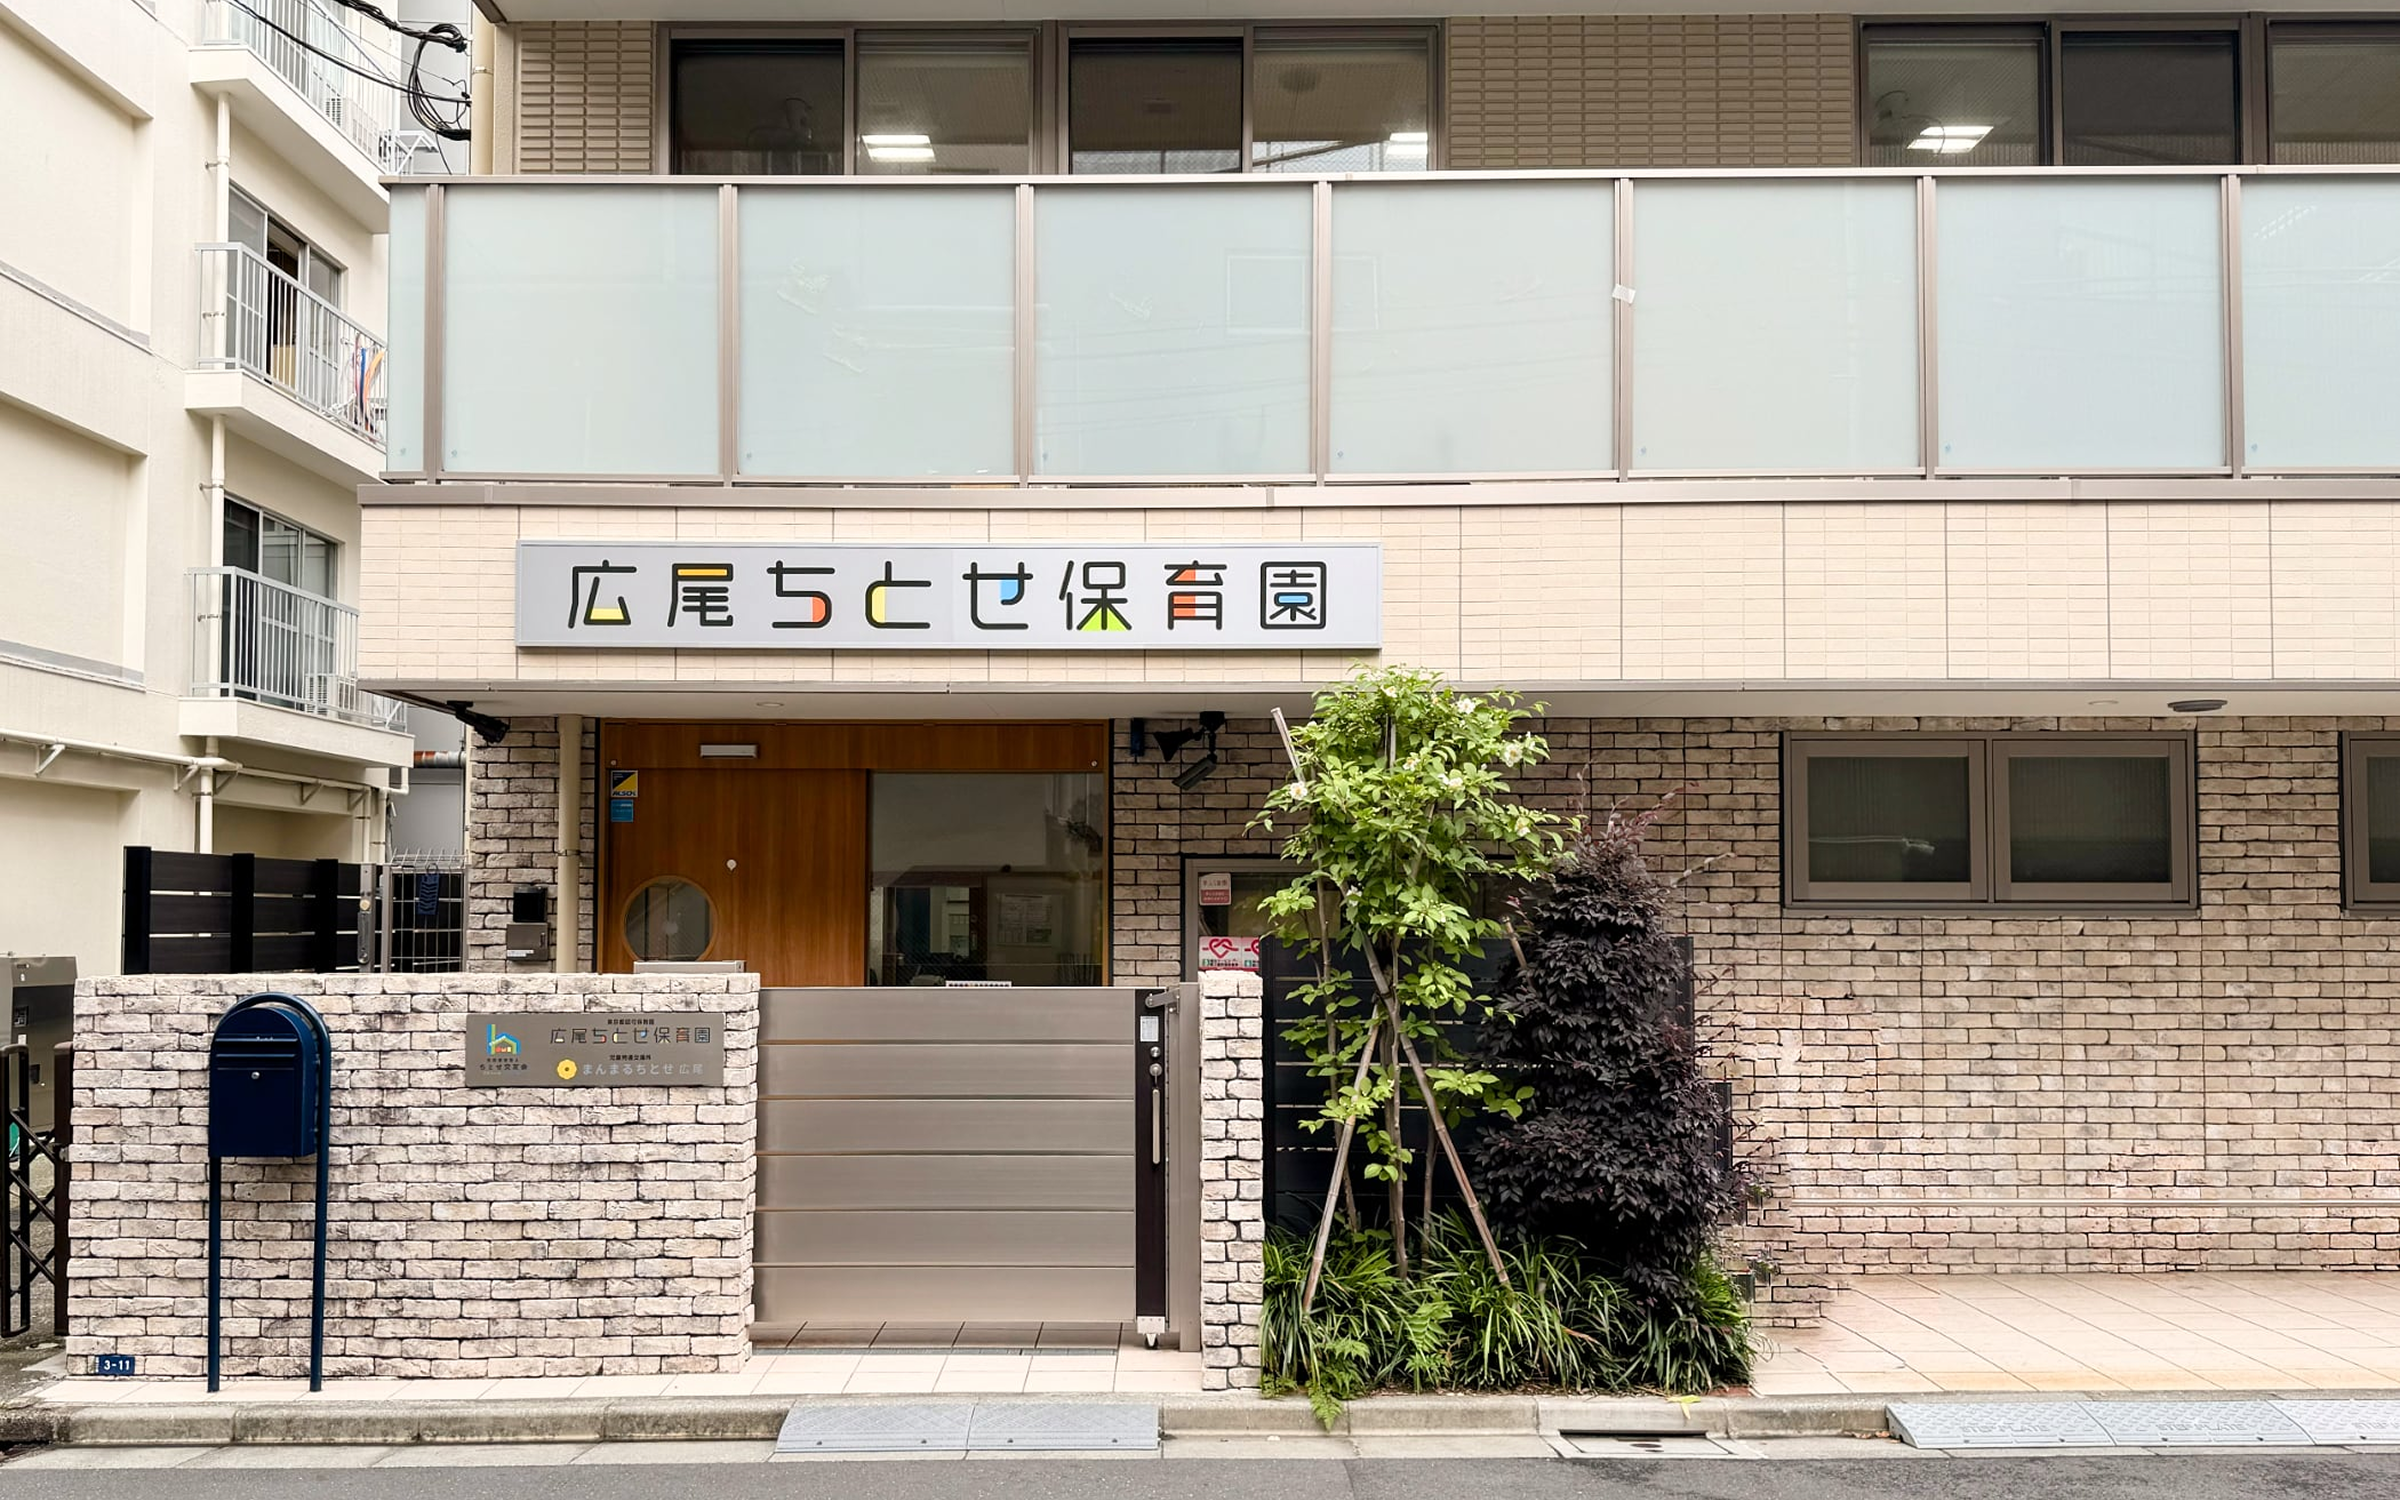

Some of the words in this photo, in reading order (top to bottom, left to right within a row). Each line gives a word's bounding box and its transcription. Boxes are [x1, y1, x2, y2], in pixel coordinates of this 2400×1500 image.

[568, 560, 1326, 630] 広尾ちとせ保育園
[550, 1027, 711, 1045] 広尾ちとせ保育園
[583, 1064, 674, 1076] まんまるちとせ
[679, 1064, 704, 1075] 広尾
[103, 1359, 130, 1371] 3-11
